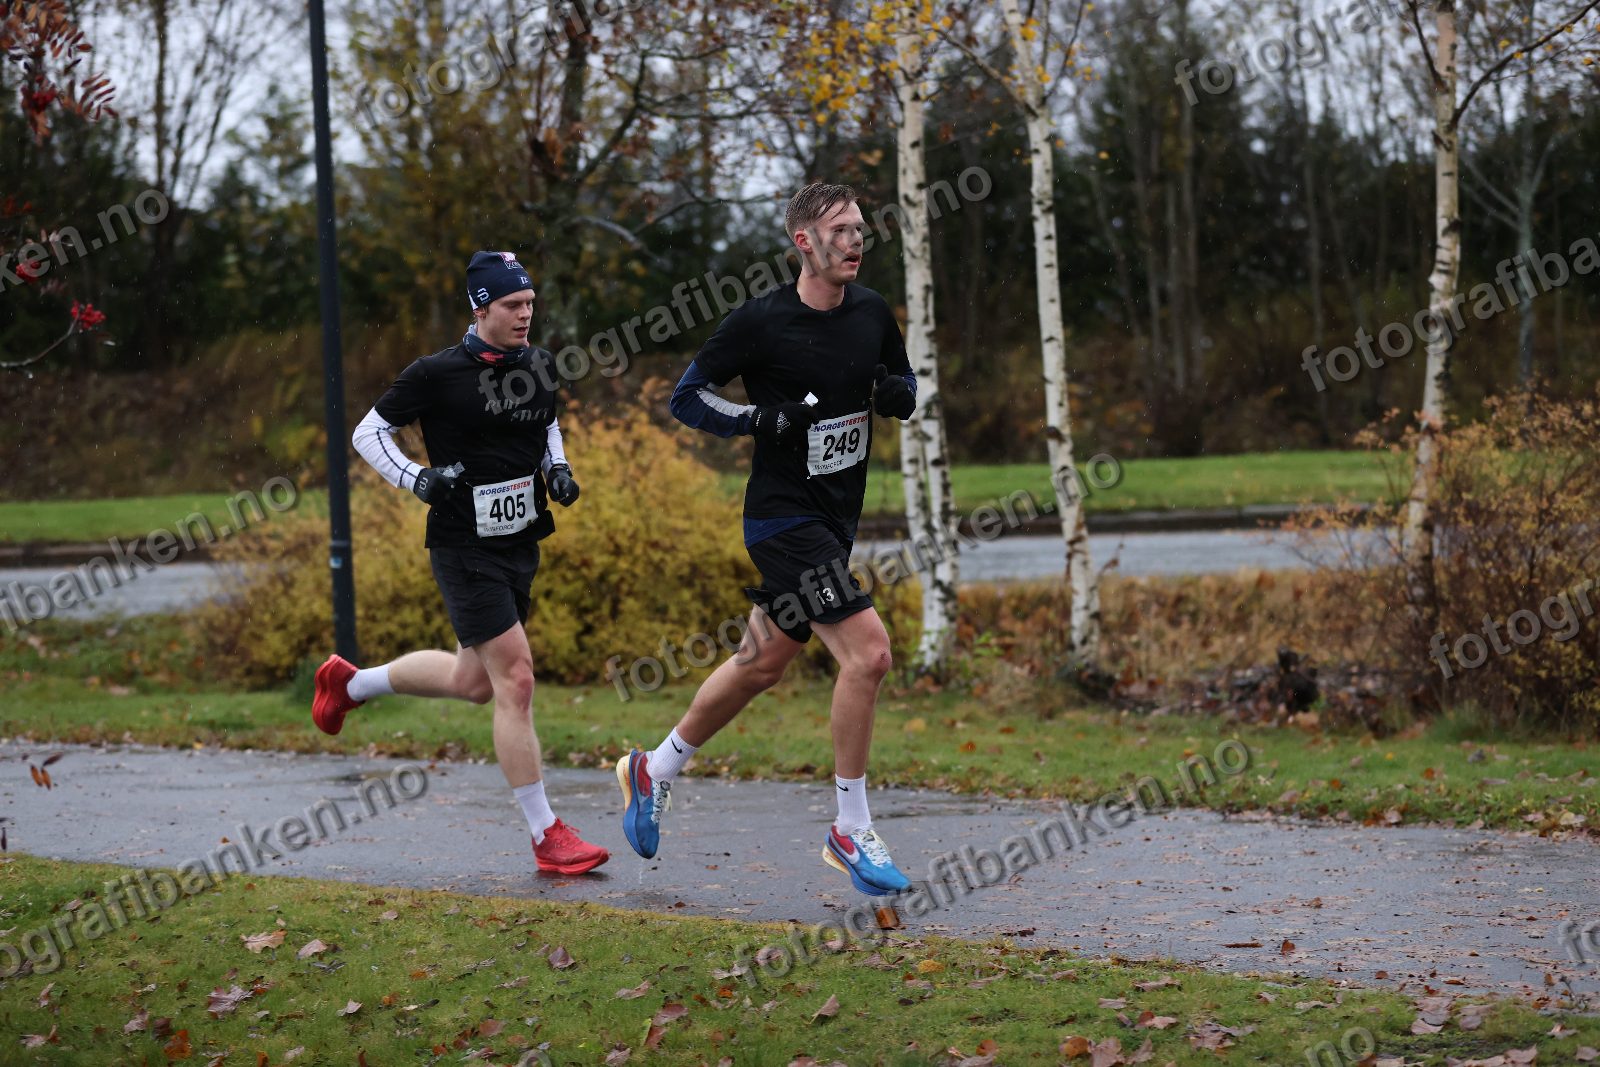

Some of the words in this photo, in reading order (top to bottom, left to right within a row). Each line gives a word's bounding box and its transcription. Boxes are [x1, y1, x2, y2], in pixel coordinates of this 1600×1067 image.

[823, 427, 861, 461] 249
[479, 480, 532, 496] NORGESTESTEN
[490, 493, 526, 522] 405
[816, 587, 835, 605] 13
